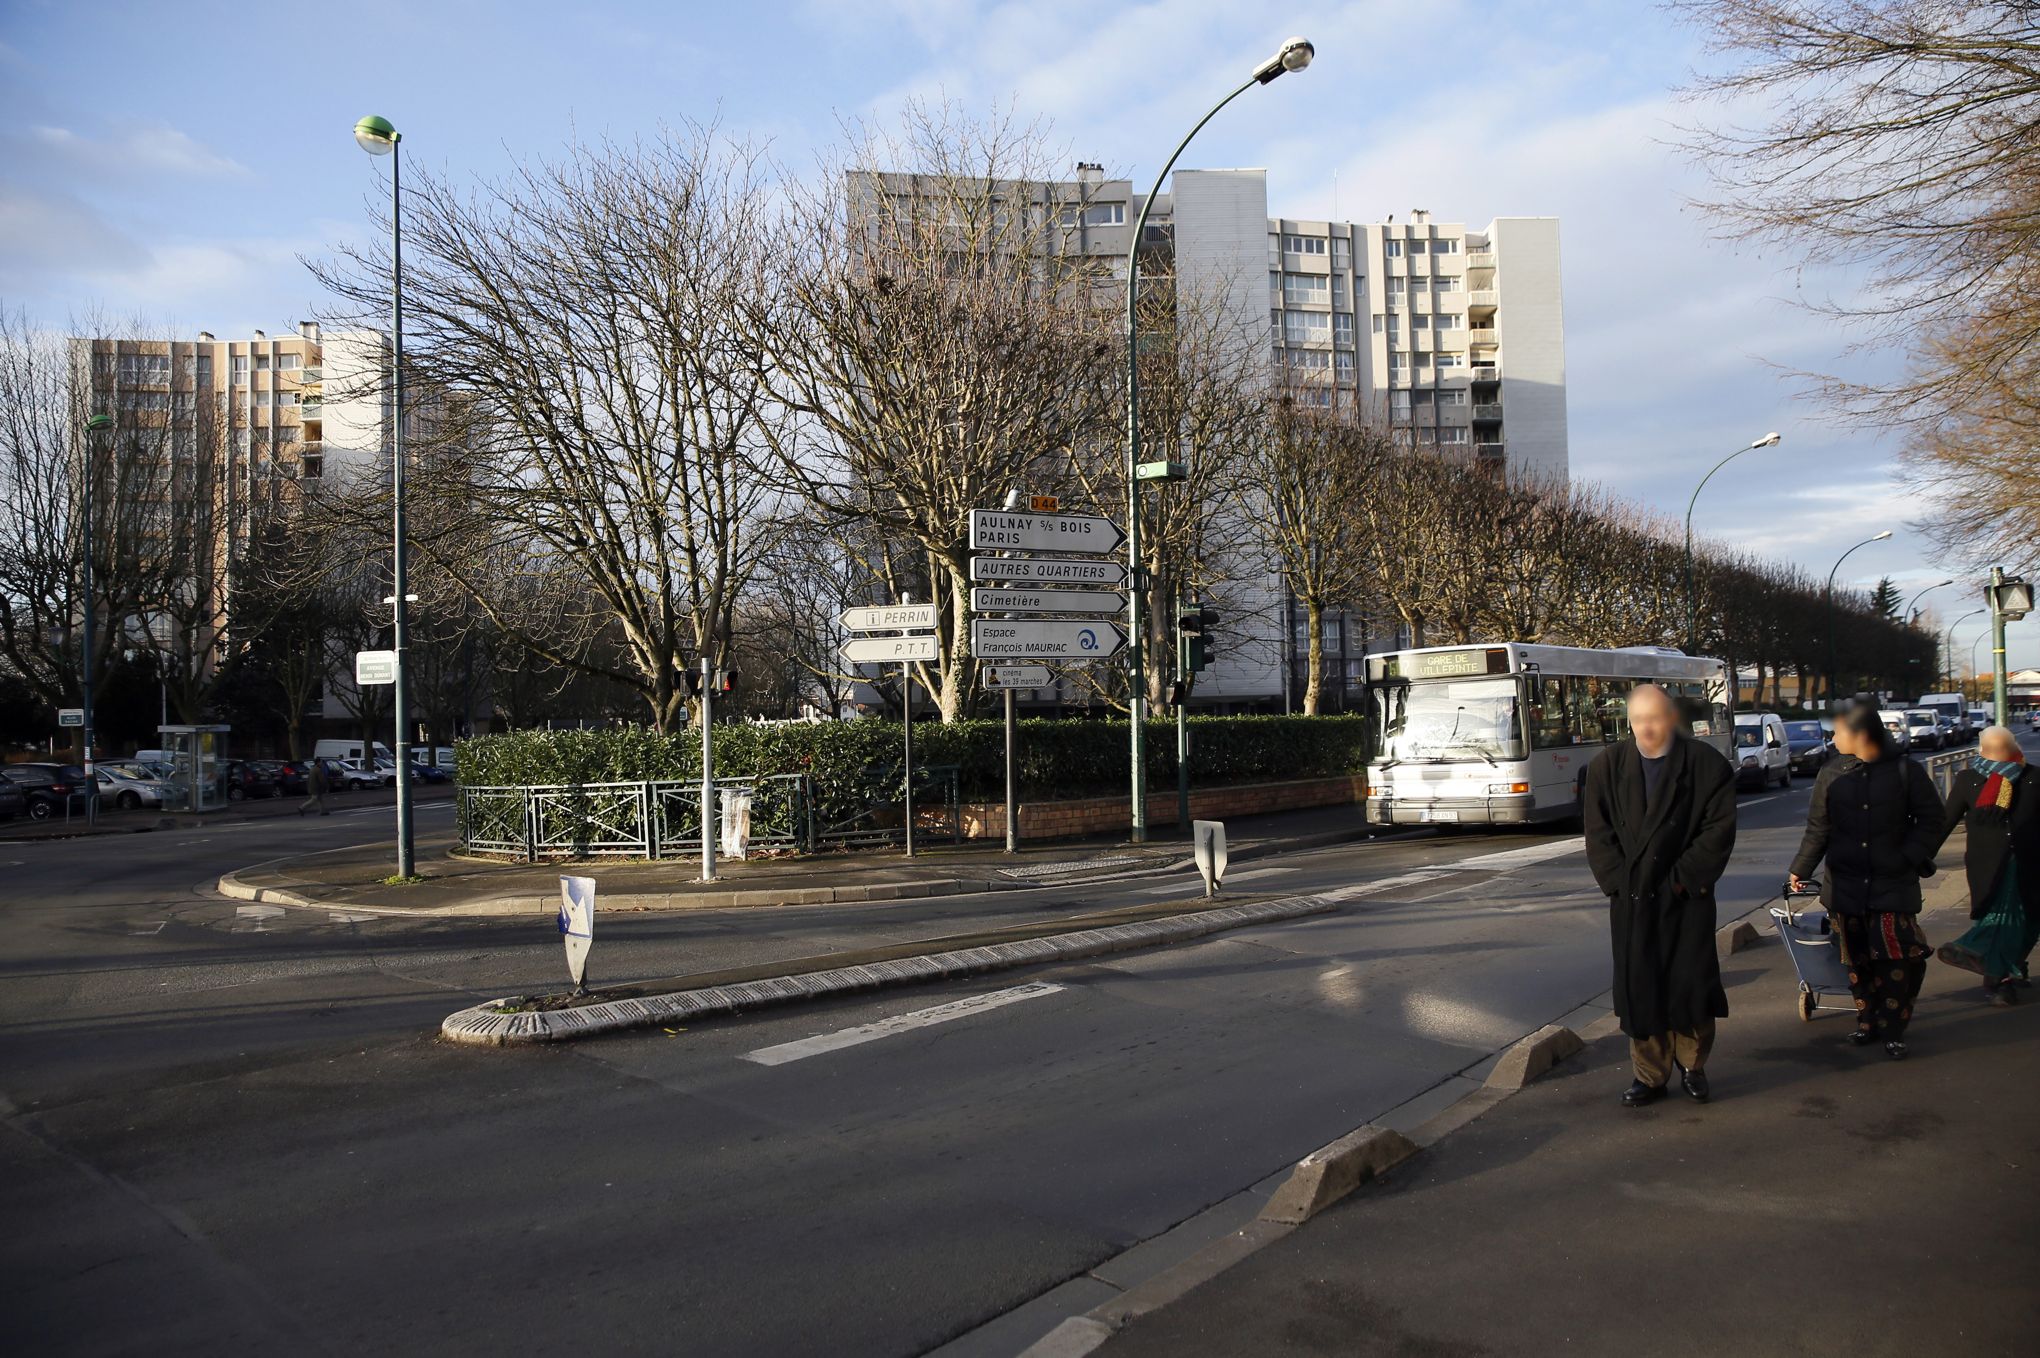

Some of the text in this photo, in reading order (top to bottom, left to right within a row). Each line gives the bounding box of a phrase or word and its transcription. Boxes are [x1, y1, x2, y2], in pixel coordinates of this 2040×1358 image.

[1032, 498, 1056, 508] D 44
[980, 516, 1033, 530] AULNAY
[1060, 521, 1091, 534] BOIS
[980, 531, 1020, 544] PARIS
[980, 563, 1106, 578] AUTRES QUARTIERS
[981, 594, 1040, 607] Cimetière
[884, 611, 929, 624] PERRIN
[983, 628, 1016, 639] Espace
[894, 642, 931, 655] P.T.T.
[983, 643, 1068, 653] François MAURIAC
[1427, 654, 1468, 666] GARE DE
[1420, 663, 1478, 676] VILLEPINTE
[1020, 678, 1043, 686] marches
